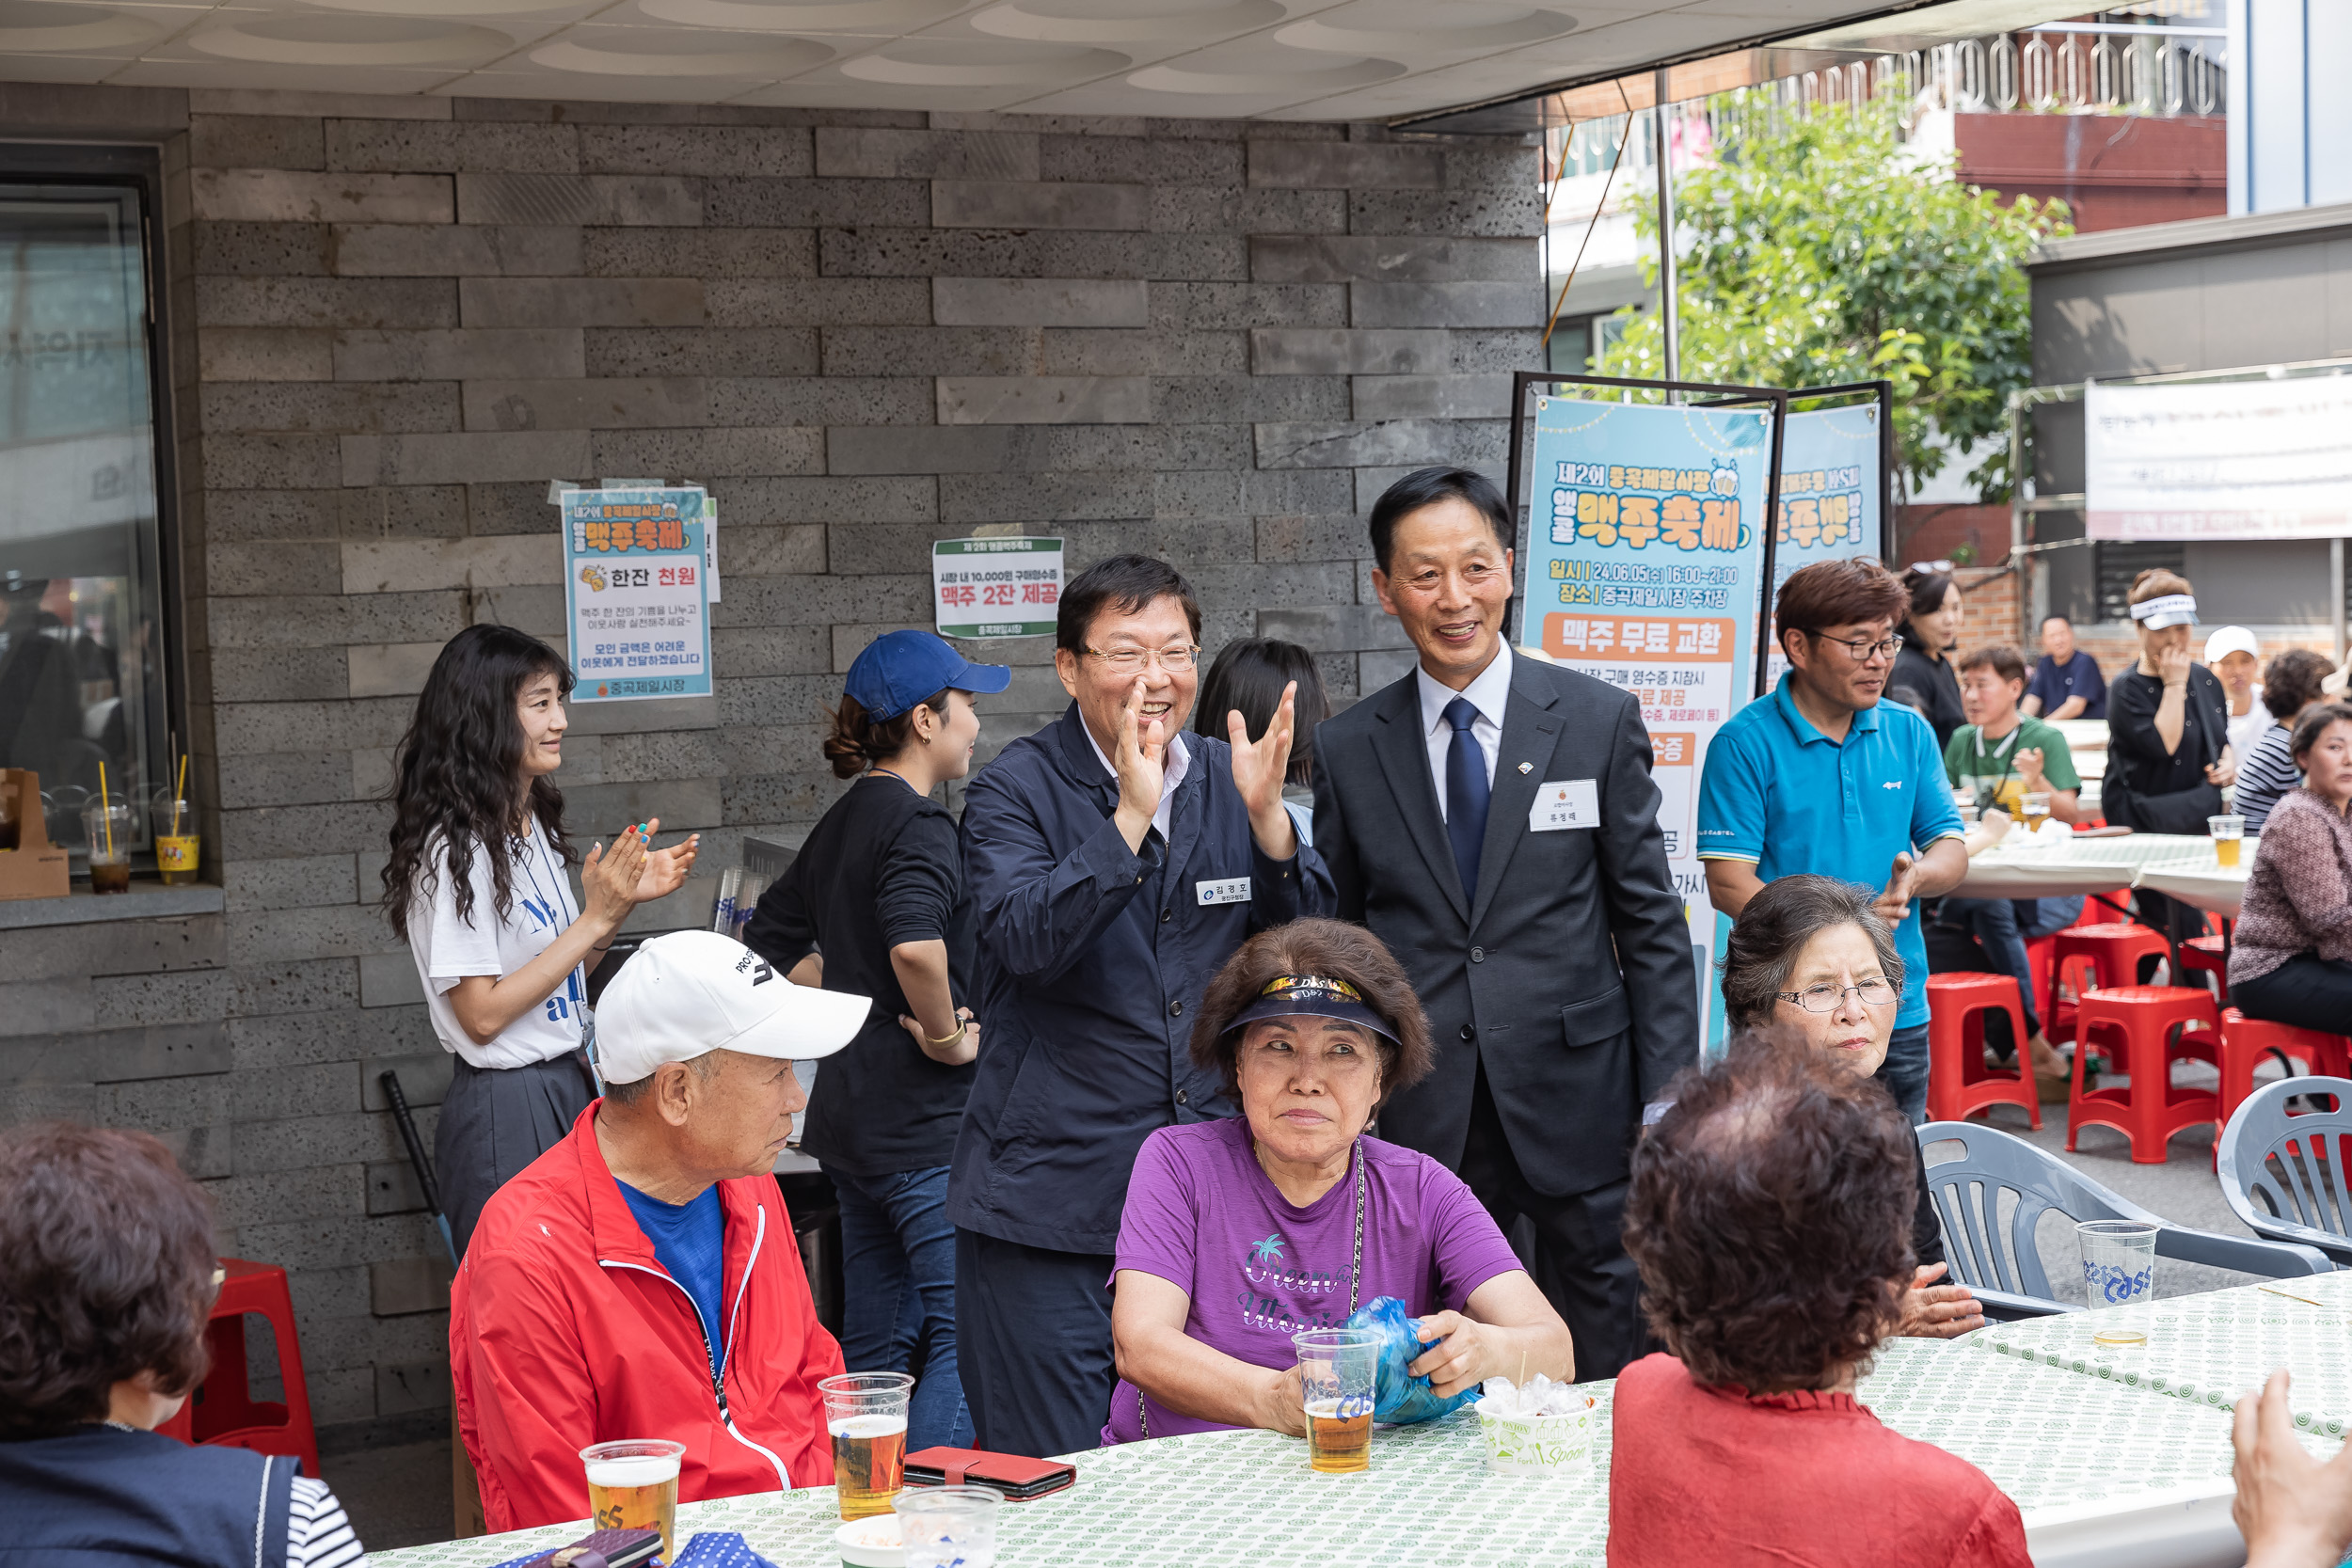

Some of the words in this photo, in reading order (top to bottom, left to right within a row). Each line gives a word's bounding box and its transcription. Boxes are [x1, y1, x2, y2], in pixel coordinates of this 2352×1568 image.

[1556, 461, 1605, 486] 제2회
[1609, 465, 1712, 493] 중곡제일시장
[1550, 488, 1579, 545] 앵콜
[1577, 491, 1740, 552] 맥주축제
[586, 519, 683, 552] 맥주축제
[612, 569, 649, 588] 한잔
[659, 567, 696, 587] 천원
[1549, 560, 1581, 580] 일시
[1593, 562, 1664, 583] 24.06.05(수)
[941, 585, 977, 608] 맥주
[982, 584, 1015, 606] 2잔
[1022, 582, 1058, 604] 제공
[1559, 584, 1591, 604] 장소
[1602, 586, 1688, 608] 중곡제일시장
[1690, 590, 1728, 609] 주차장
[668, 604, 697, 616] 나누고
[1563, 618, 1615, 653] 맥주
[1621, 622, 1671, 654] 무료
[1675, 623, 1723, 656] 교환
[595, 643, 616, 656] 모인
[619, 641, 651, 654] 금액은
[654, 641, 686, 652] 어려운
[580, 657, 624, 669] 이웃에게
[627, 653, 700, 667] 전달하겠습니다
[611, 679, 686, 696] 중곡제일시장
[1632, 670, 1669, 686] 영수증
[1671, 670, 1705, 686] 지참시
[1659, 689, 1686, 706] 제공
[1502, 1420, 1529, 1434] ONION
[1517, 1457, 1534, 1465] Fork
[1546, 1446, 1587, 1468] Spoon
